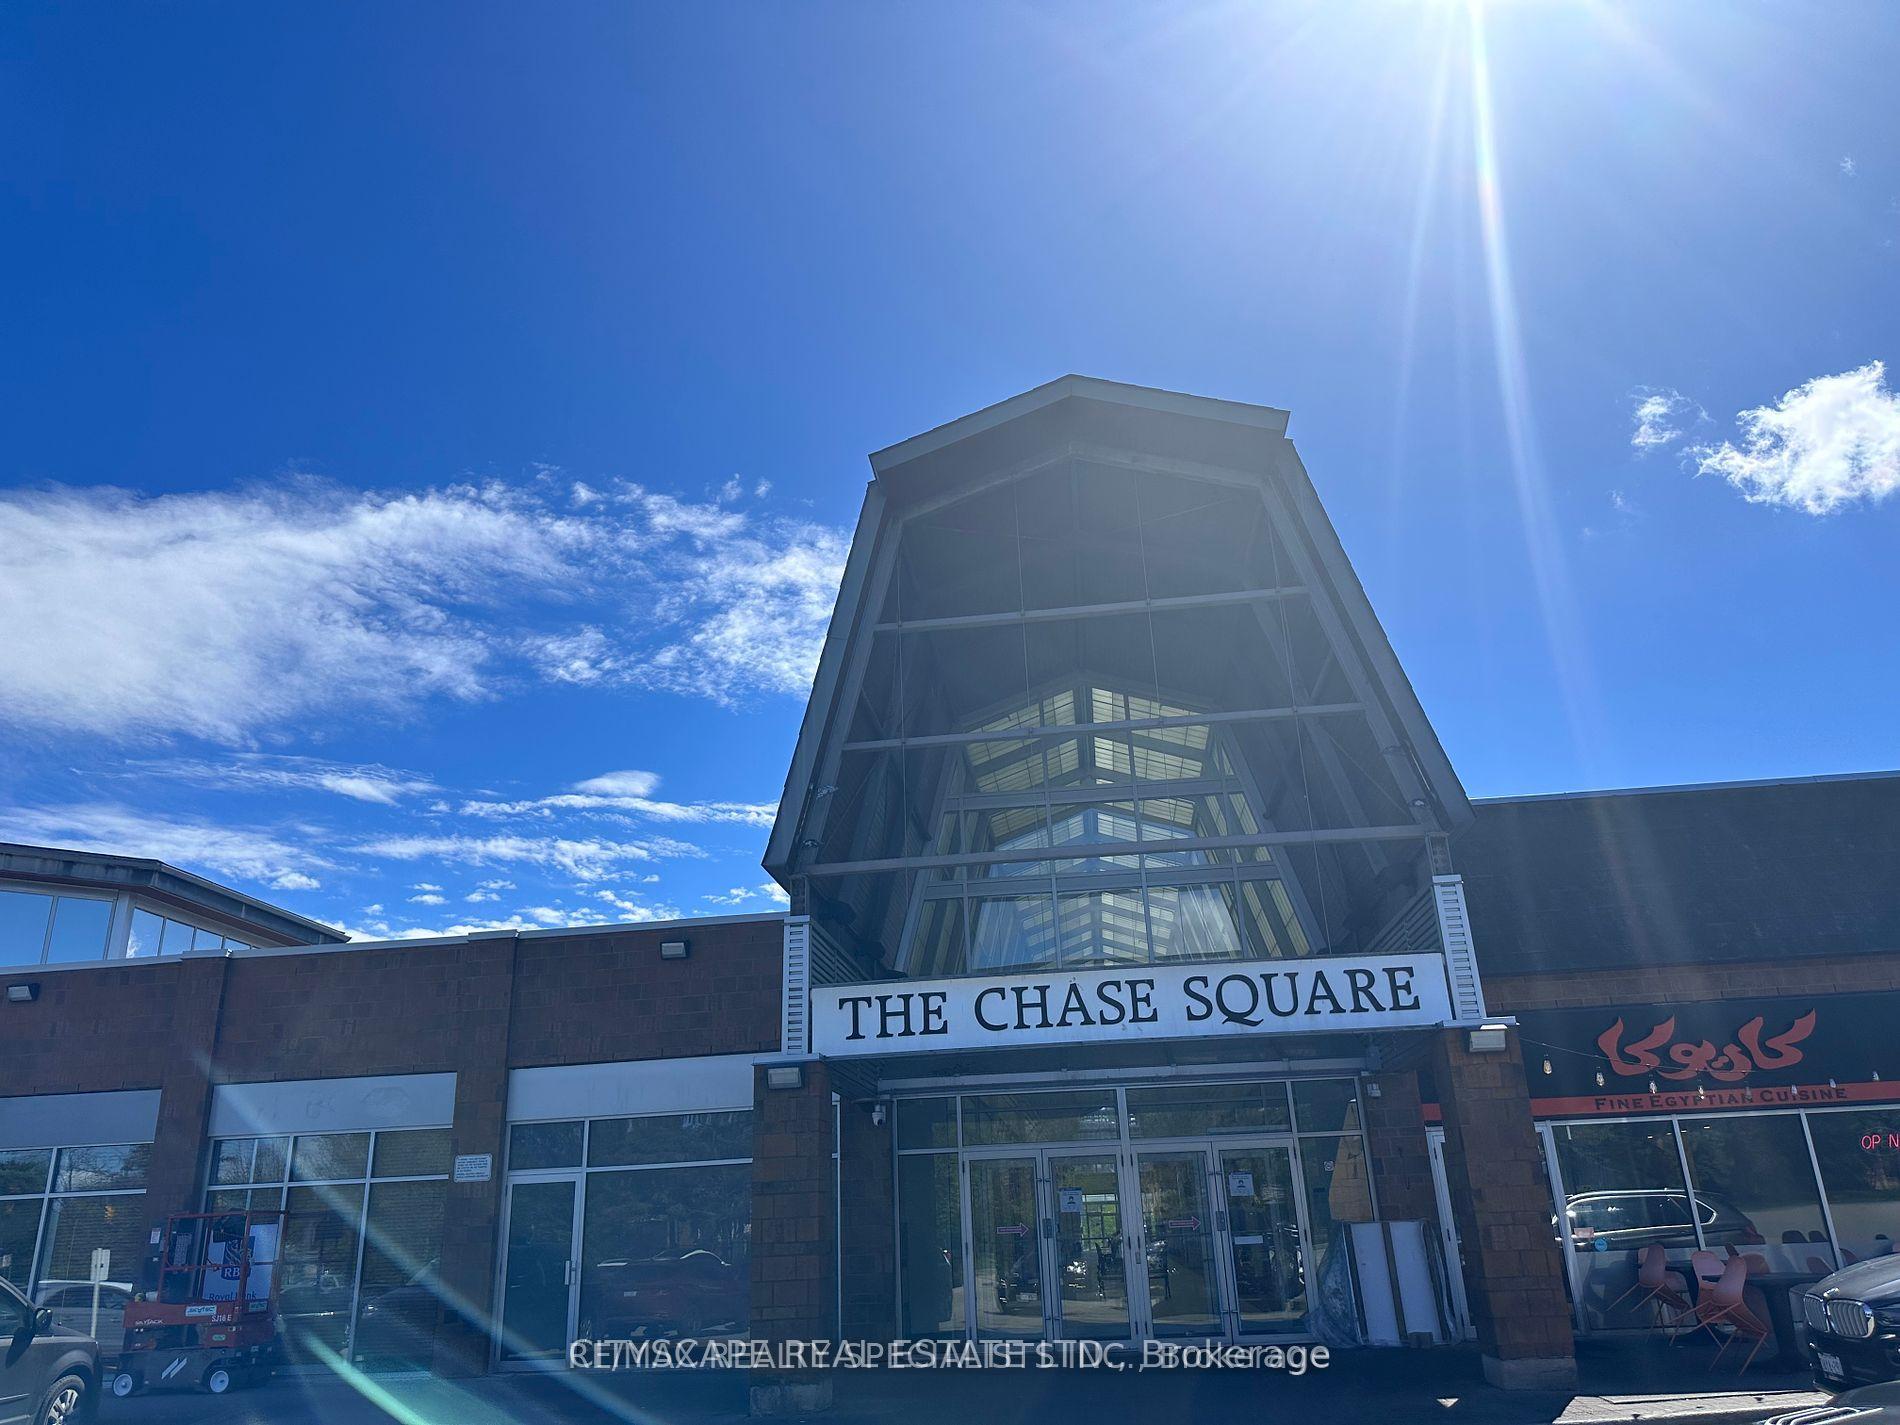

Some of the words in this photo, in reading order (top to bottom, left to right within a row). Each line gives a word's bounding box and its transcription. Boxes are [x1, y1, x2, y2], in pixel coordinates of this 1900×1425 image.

[838, 991, 948, 1040] THE
[974, 978, 1158, 1031] CHASE
[1183, 966, 1421, 1027] SQUARE
[1595, 1097, 1644, 1111] FINE
[1650, 1089, 1753, 1108] EGYPTIAN
[1760, 1087, 1848, 1103] CUISINE
[1861, 1133, 1899, 1150] OPN
